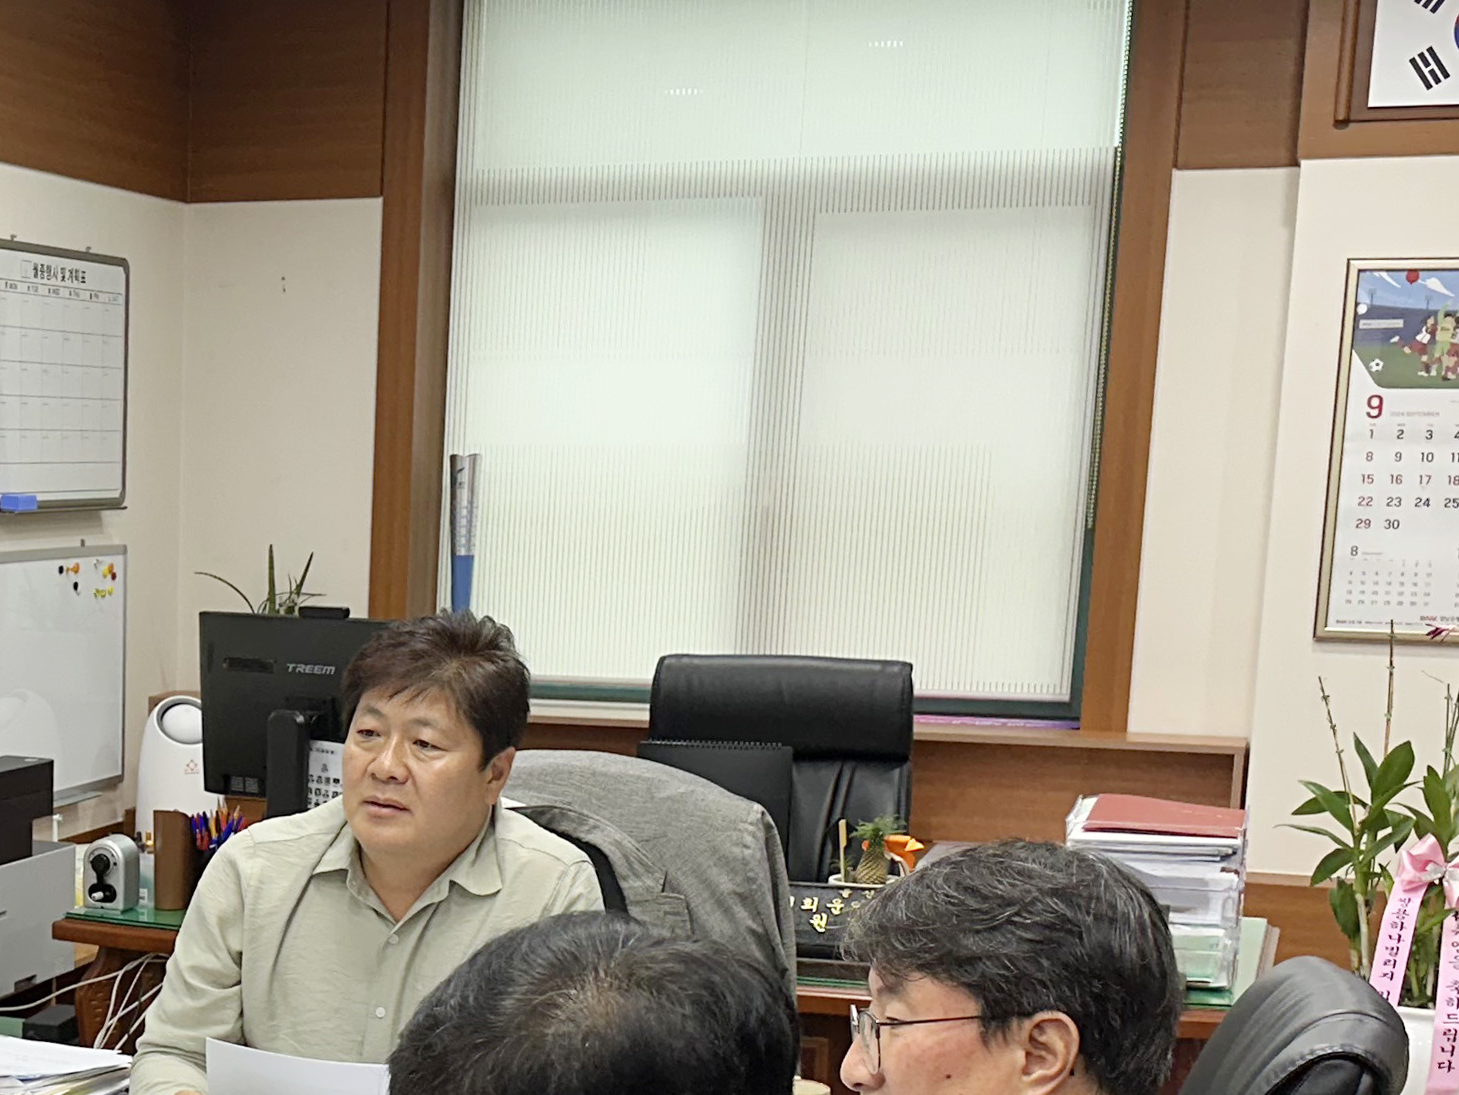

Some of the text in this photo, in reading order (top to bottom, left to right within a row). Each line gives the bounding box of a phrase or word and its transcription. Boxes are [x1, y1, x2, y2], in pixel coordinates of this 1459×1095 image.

[1366, 394, 1384, 419] 9
[1369, 429, 1374, 439] 1
[1396, 429, 1405, 440] 2
[1425, 429, 1433, 440] 3
[1365, 451, 1373, 462] 8
[1394, 452, 1402, 463] 9
[1420, 452, 1434, 463] 10
[1361, 474, 1459, 486] 15 16 17 18
[1357, 496, 1459, 508] 22 23 24 25
[1355, 518, 1400, 530] 29 30
[1350, 546, 1359, 557] 8
[286, 663, 335, 675] TREEM
